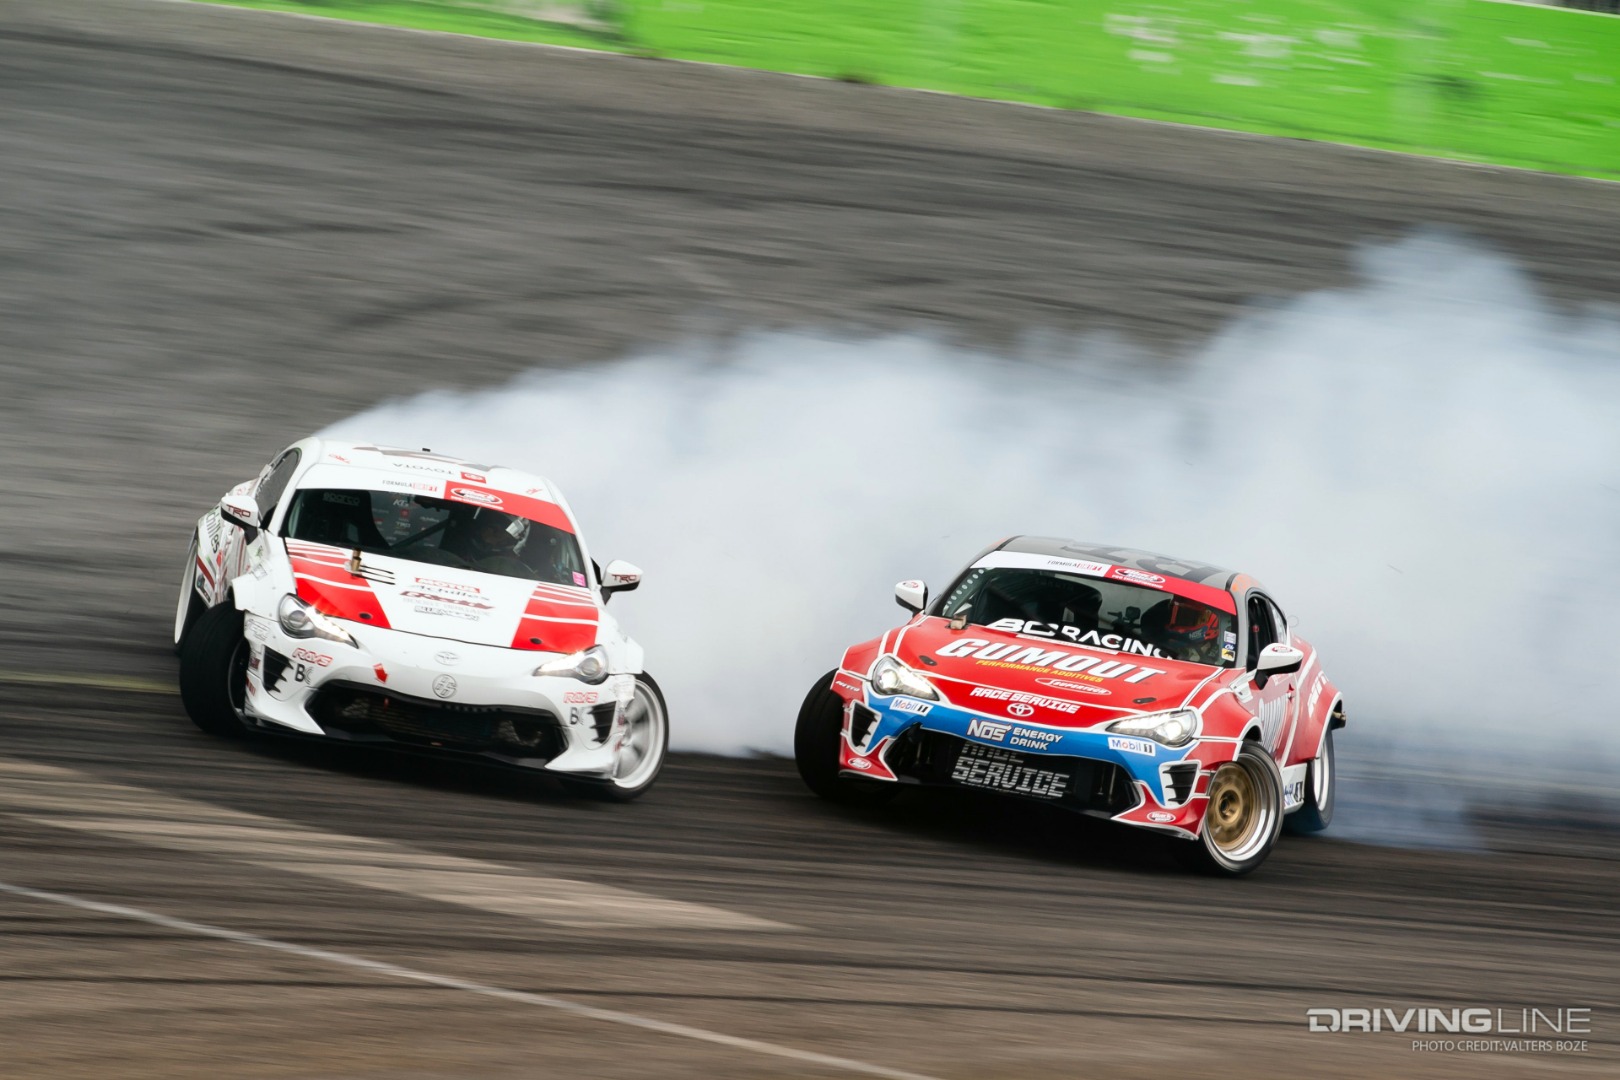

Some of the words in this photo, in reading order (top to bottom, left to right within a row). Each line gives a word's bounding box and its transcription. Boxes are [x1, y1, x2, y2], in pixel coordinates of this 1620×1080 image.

[226, 503, 251, 518] TRD
[611, 574, 637, 584] TRD
[985, 617, 1059, 637] BC
[292, 647, 333, 668] RAYS
[935, 637, 1168, 685] GUMOUT
[976, 660, 1051, 674] PERFORMANCE
[1050, 669, 1104, 683] ADDITIVES
[563, 691, 599, 704] RAYS
[893, 699, 917, 711] Mobil
[969, 686, 1013, 701] RACE
[1010, 692, 1082, 714] SERVICE
[966, 718, 1012, 742] NOS
[1012, 727, 1063, 743] ENERGY
[1009, 736, 1049, 751] DRINK
[1111, 739, 1142, 751] Mobil
[951, 756, 1070, 798] SERVICE
